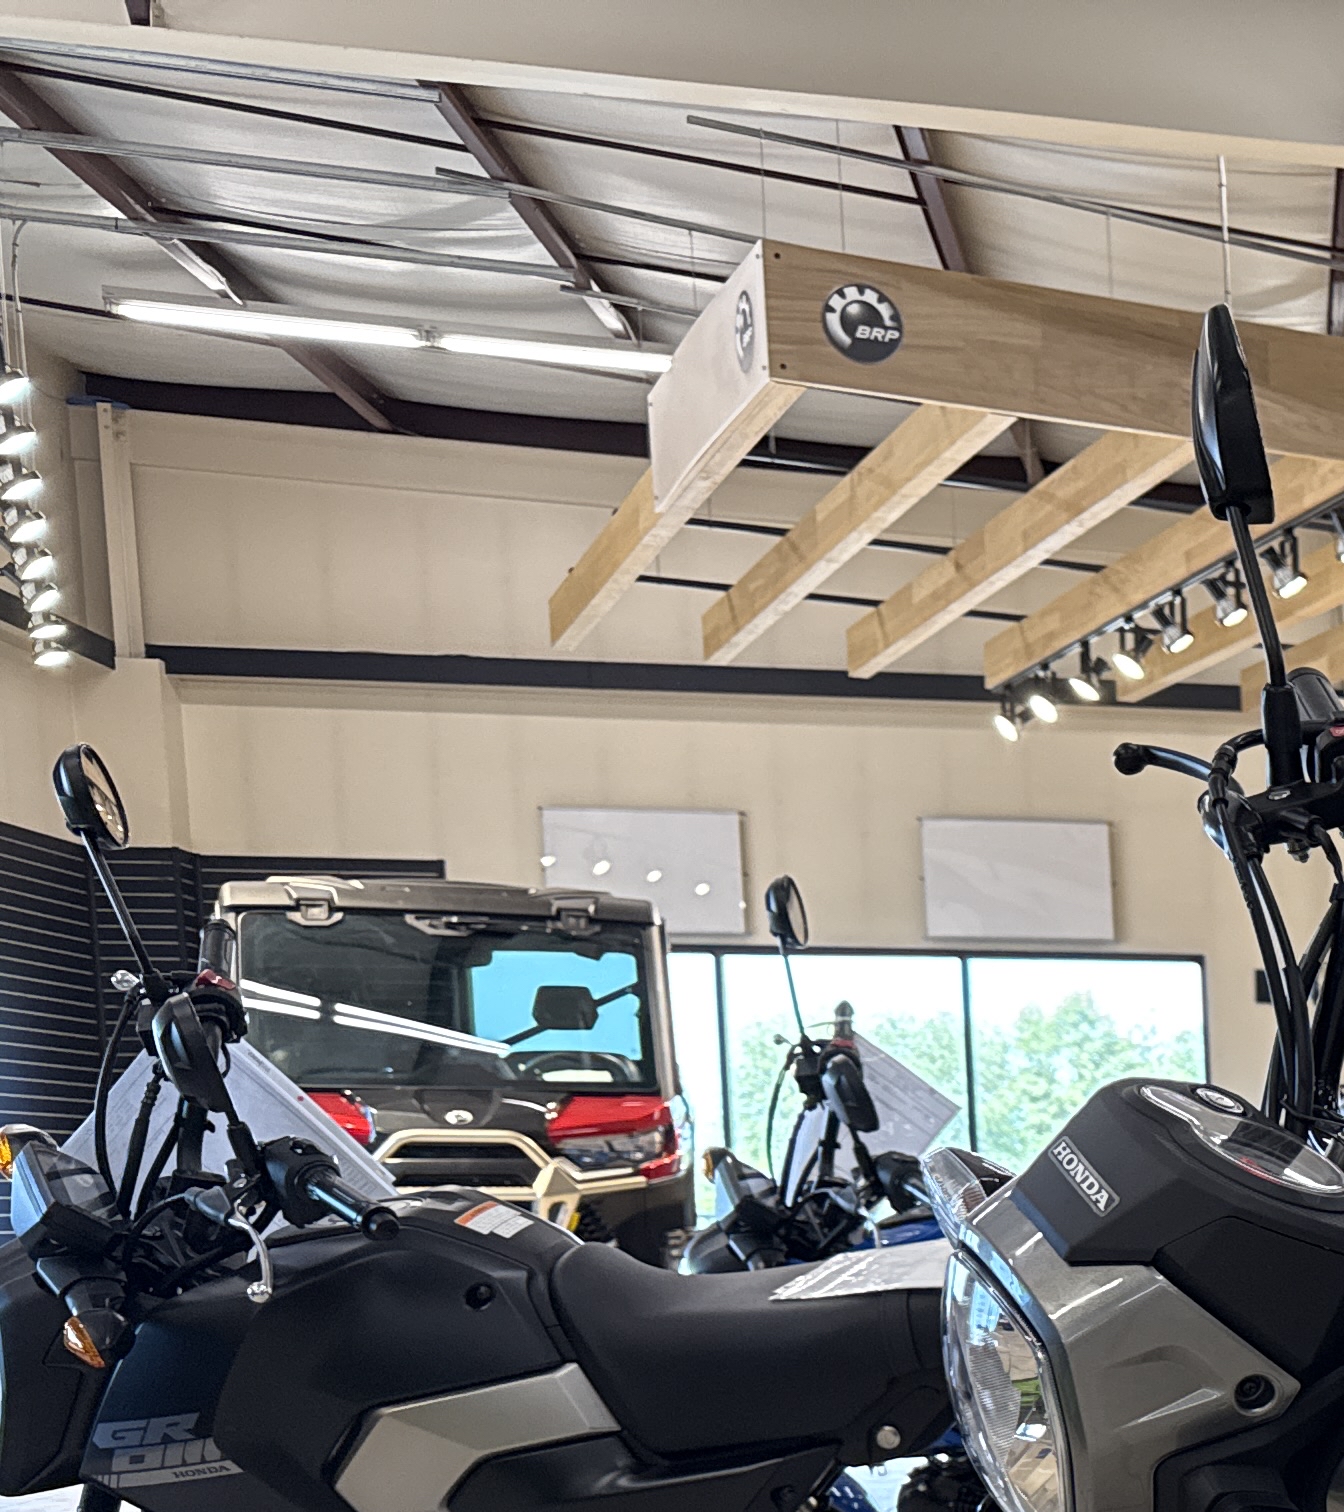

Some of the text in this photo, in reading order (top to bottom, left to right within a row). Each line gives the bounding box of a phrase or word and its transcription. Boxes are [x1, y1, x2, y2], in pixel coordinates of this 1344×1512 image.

[855, 325, 900, 343] BRP
[1052, 1141, 1109, 1212] HONDA
[172, 1465, 232, 1479] HONDA
